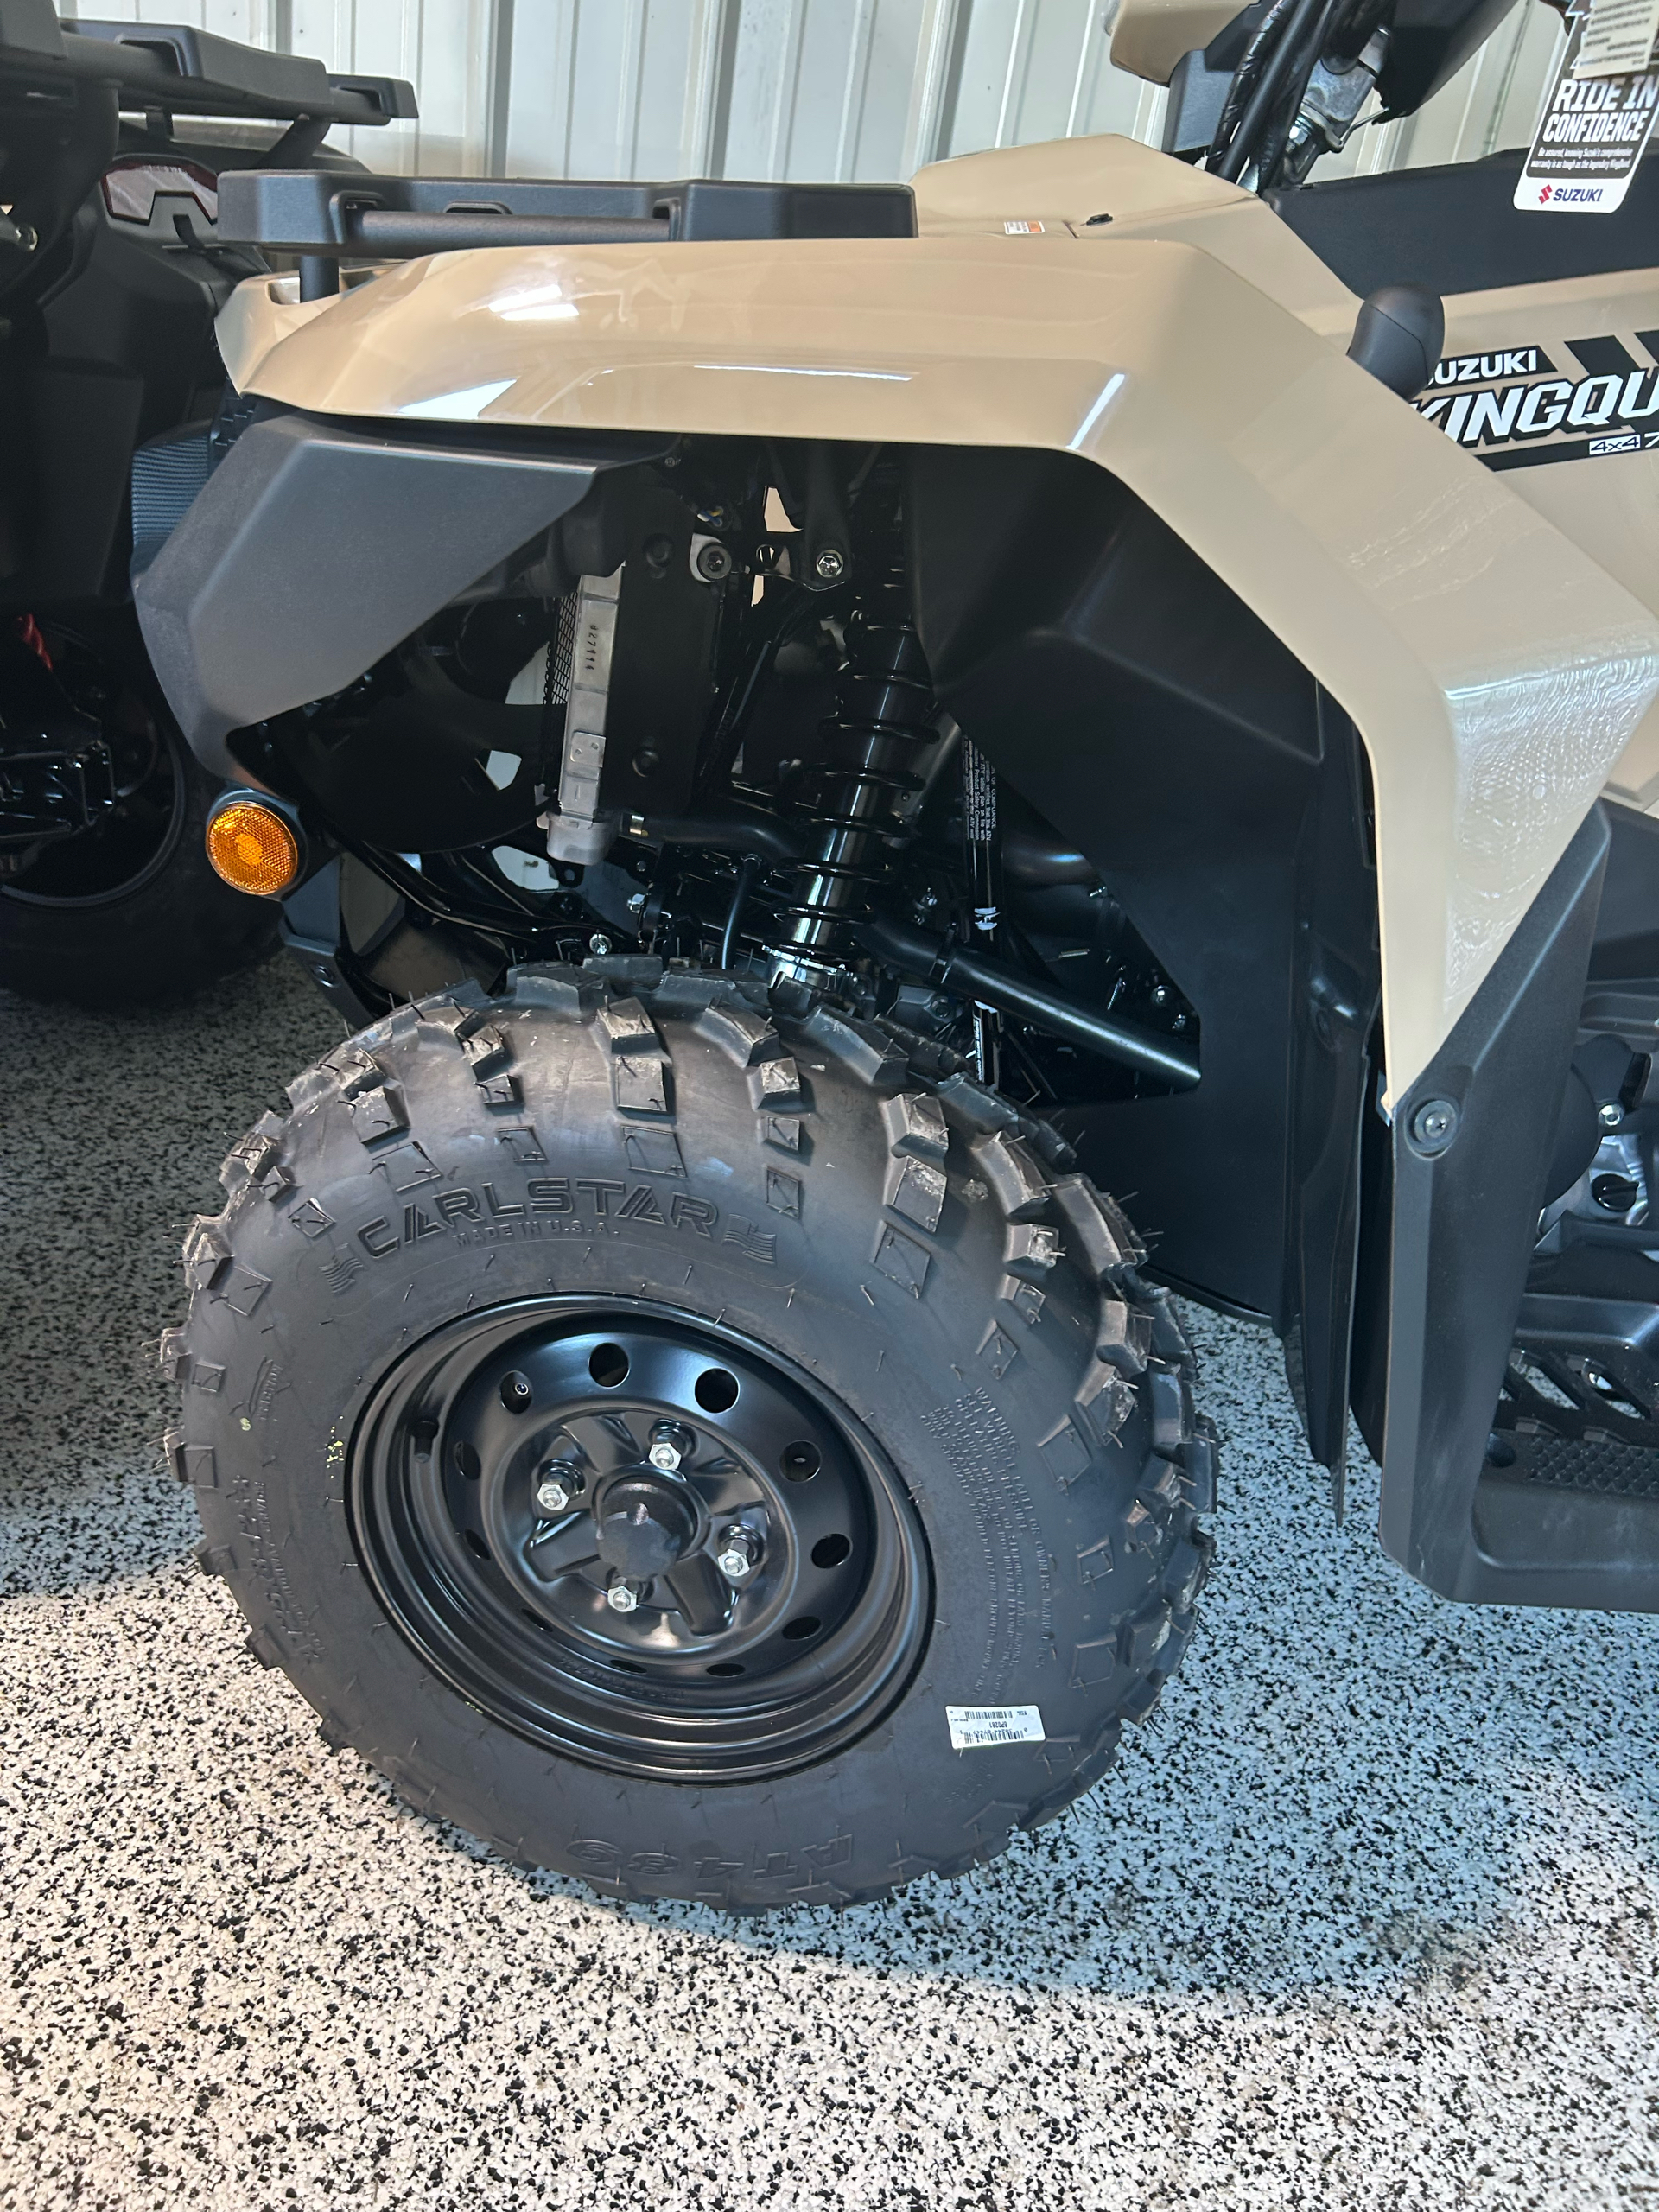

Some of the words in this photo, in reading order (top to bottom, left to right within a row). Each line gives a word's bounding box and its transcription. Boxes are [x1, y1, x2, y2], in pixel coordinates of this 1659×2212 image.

[1552, 79, 1624, 111] RIDE
[1624, 76, 1655, 109] IN
[1542, 111, 1651, 143] CONFIDENCE
[1553, 188, 1604, 202] SUZUKI
[1591, 436, 1640, 452] 4x4
[357, 1178, 719, 1259] CARLSTAR
[452, 1222, 513, 1249] MADE
[517, 1221, 542, 1240] IN
[951, 1397, 1002, 1465] OPERATING
[1027, 1517, 1041, 1534] OR
[566, 1834, 854, 1880] AT489
